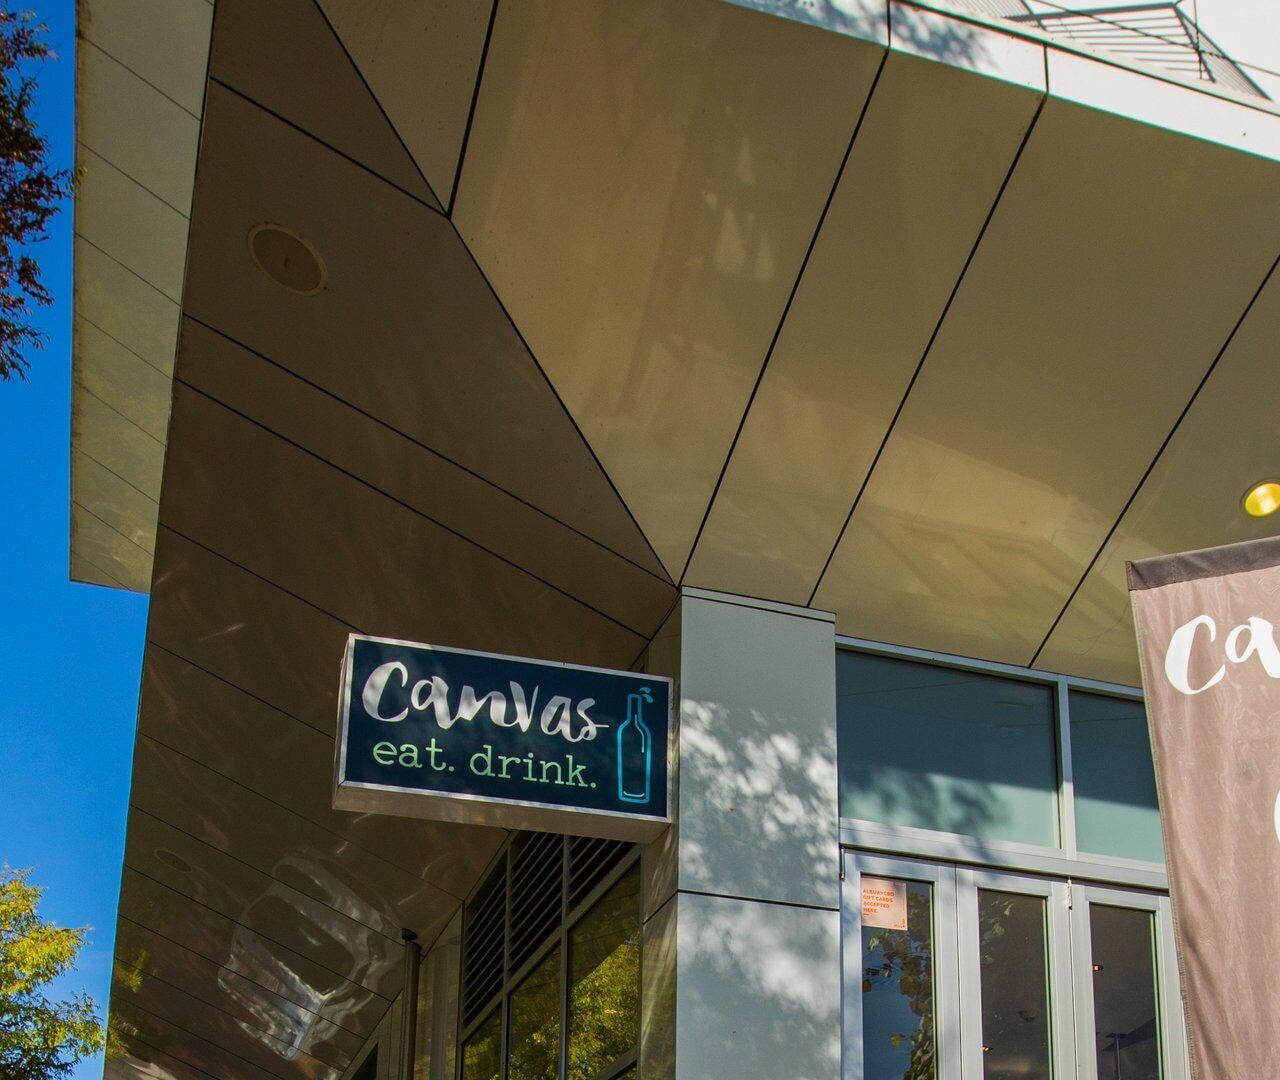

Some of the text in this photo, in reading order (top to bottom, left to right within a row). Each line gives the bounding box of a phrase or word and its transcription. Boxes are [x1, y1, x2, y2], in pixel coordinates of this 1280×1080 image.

[361, 660, 610, 743] Canvas
[372, 737, 597, 789] eat. drink.
